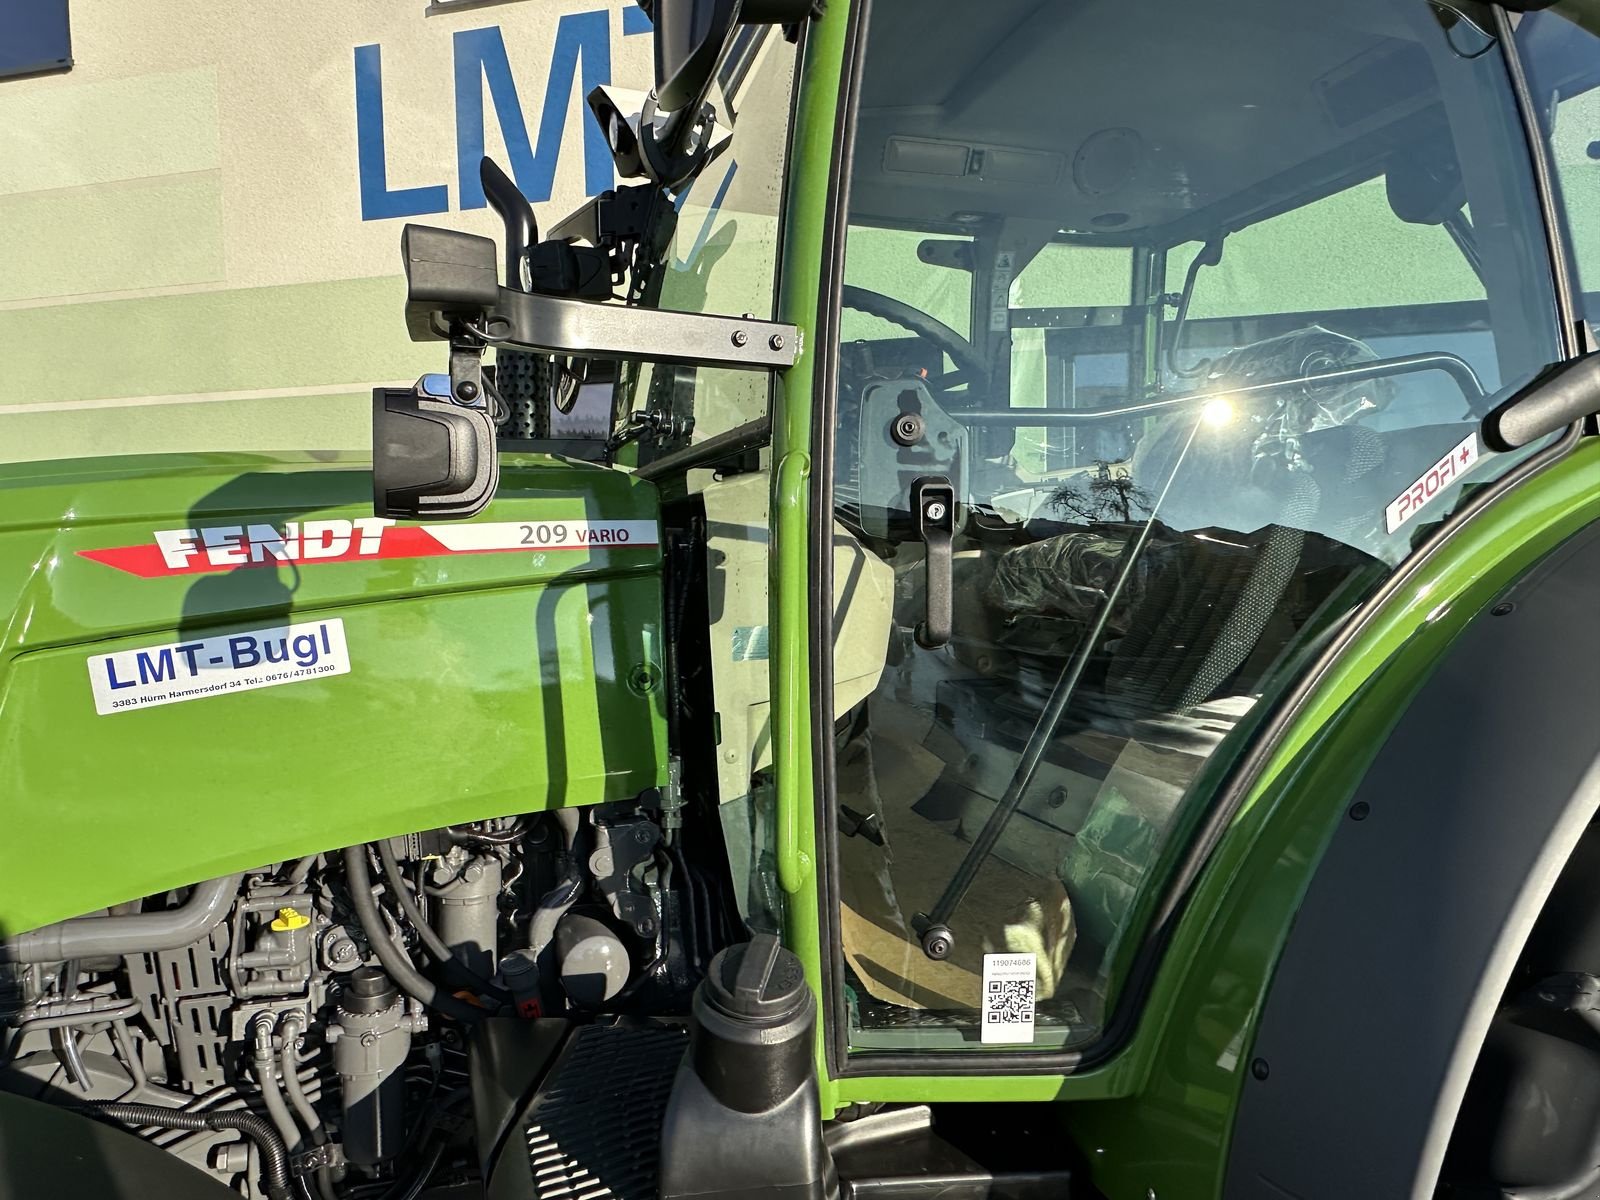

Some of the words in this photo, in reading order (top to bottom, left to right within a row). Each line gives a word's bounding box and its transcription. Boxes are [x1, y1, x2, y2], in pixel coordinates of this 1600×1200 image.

[354, 4, 654, 221] LM
[153, 517, 397, 569] FENDT
[519, 524, 568, 544] 209
[575, 528, 630, 543] VARIO
[105, 624, 331, 690] LMT-Bugl
[112, 698, 138, 708] 3383
[140, 694, 167, 704] Hürm
[168, 682, 228, 699] Harmersdorf
[229, 680, 242, 688] 34
[265, 664, 336, 682] 0676/4781300
